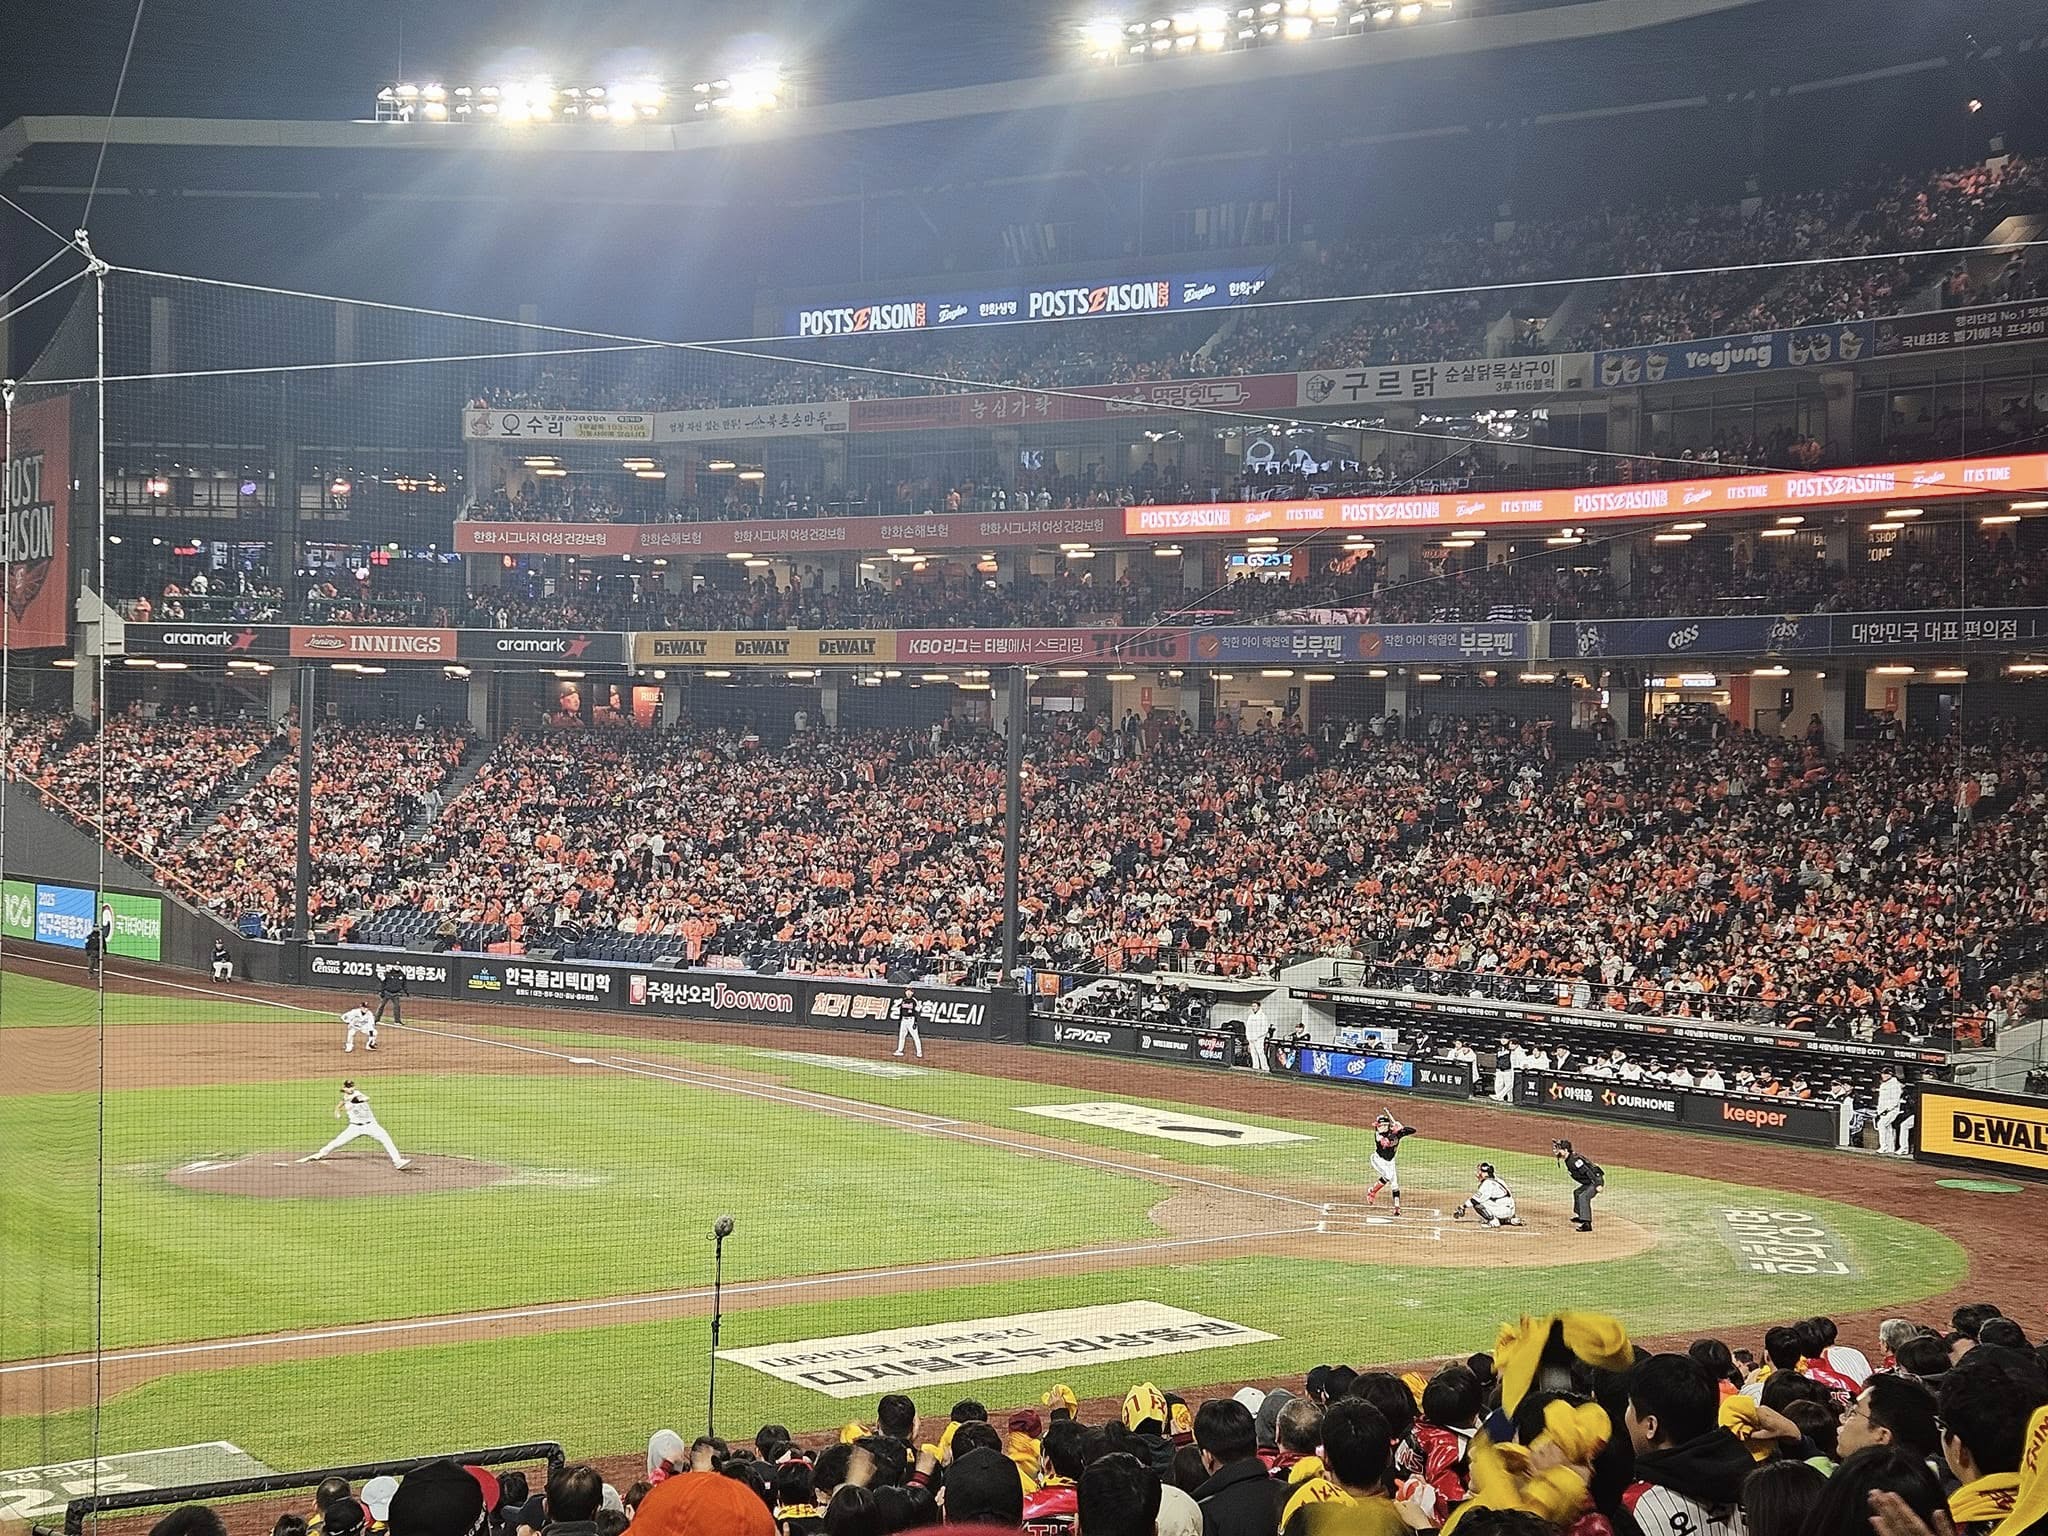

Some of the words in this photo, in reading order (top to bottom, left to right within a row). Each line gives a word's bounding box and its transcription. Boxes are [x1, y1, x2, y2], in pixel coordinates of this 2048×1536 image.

[979, 302, 1017, 317] 한화생명
[1029, 284, 1158, 317] POSTSEASON
[800, 303, 916, 335] POSTSEASON
[1902, 332, 1949, 348] 국내최초
[2007, 321, 2044, 336] 프라이
[1445, 359, 1555, 383] 순살닭목살구이
[1342, 366, 1438, 398] 구르닭
[1496, 382, 1513, 392] 3루
[501, 413, 564, 437] 오수리
[1787, 473, 1887, 498] POSTSEASON
[1574, 490, 1662, 512] POSTSEASON
[1141, 510, 1225, 529] POSTSEASON
[1342, 503, 1433, 521] POSTSEASON
[733, 529, 752, 543] 한화
[752, 529, 789, 542] 시그니처
[790, 528, 809, 542] 여성
[810, 526, 846, 541] 건강보험
[880, 524, 949, 540] 한화손해보험
[980, 523, 1001, 536] 한화
[1002, 522, 1041, 536] 시그니처
[1043, 521, 1063, 534] 여성
[1064, 518, 1104, 533] 건강보험
[473, 530, 496, 544] 한화
[498, 531, 541, 545] 시그니처
[542, 532, 564, 545] 여성
[565, 532, 607, 546] 건강보험
[640, 532, 702, 547] 한화손해보험
[163, 630, 232, 647] aramark
[1384, 634, 1402, 647] 착한
[1405, 634, 1425, 647] 아이
[1852, 623, 1920, 643] 대한민국
[1924, 622, 1958, 640] 대표
[1964, 620, 2017, 641] 편의점
[350, 635, 441, 653] INNINGS
[497, 636, 566, 653] aramark
[909, 638, 981, 654] KBO리그는
[984, 638, 1031, 653] 티빙에서
[1034, 637, 1083, 653] 스트리밍
[1222, 635, 1239, 649] 착한
[1242, 635, 1260, 648] 아이
[342, 961, 373, 976] 2025
[505, 968, 611, 993] 한국폴리텍대학
[647, 982, 714, 1007] 주원산오리
[714, 982, 793, 1013] Joowon
[1063, 1028, 1112, 1045] SPYDER
[1564, 1086, 1593, 1102] 아워홈
[1618, 1094, 1675, 1112] OURHOME
[1723, 1103, 1786, 1127] keeper
